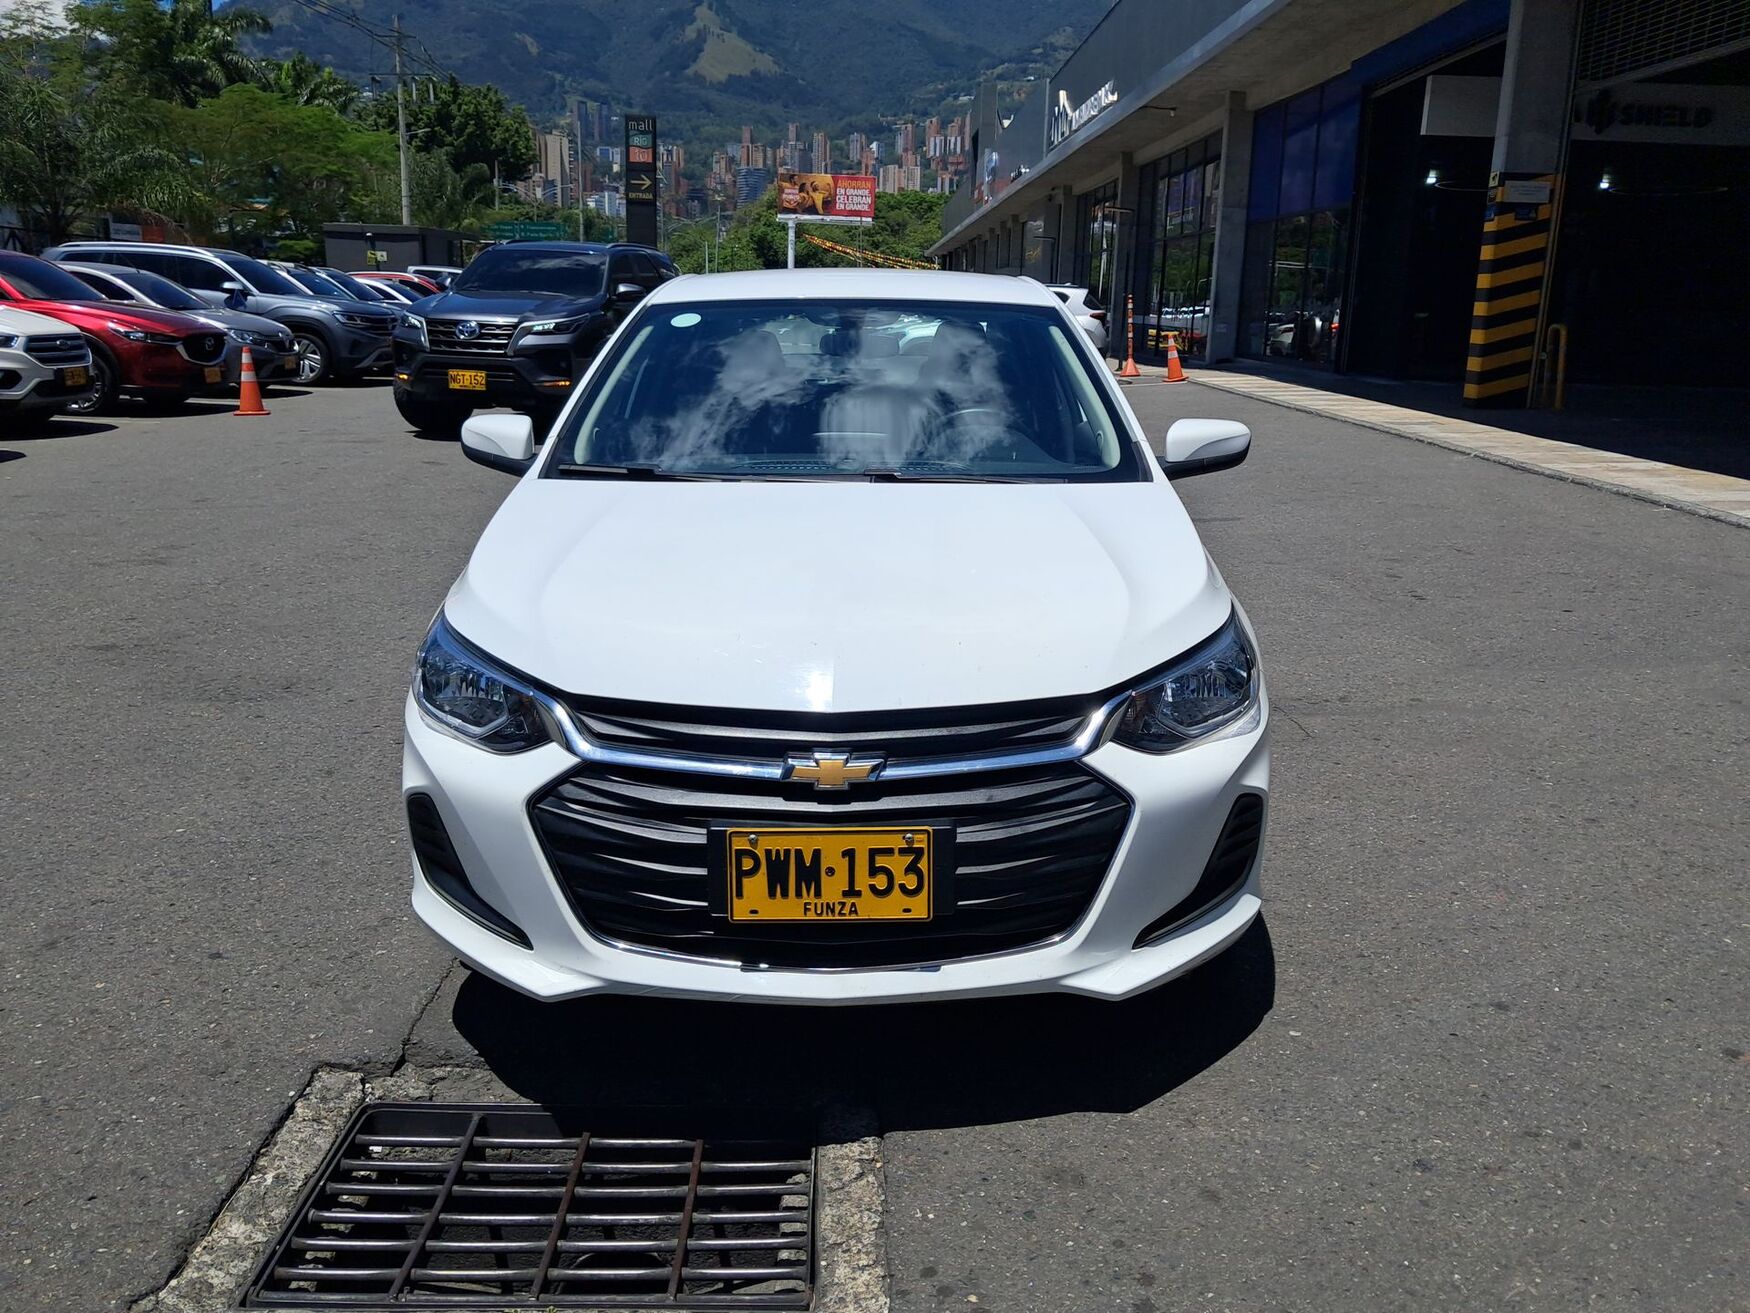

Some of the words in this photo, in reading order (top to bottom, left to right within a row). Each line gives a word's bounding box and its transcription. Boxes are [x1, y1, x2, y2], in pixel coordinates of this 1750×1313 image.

[1619, 103, 1713, 128] SHIELD
[628, 119, 653, 131] mall
[837, 180, 872, 188] AHORRAN
[836, 195, 871, 204] CELEBRAN
[803, 901, 859, 917] FUNZA
